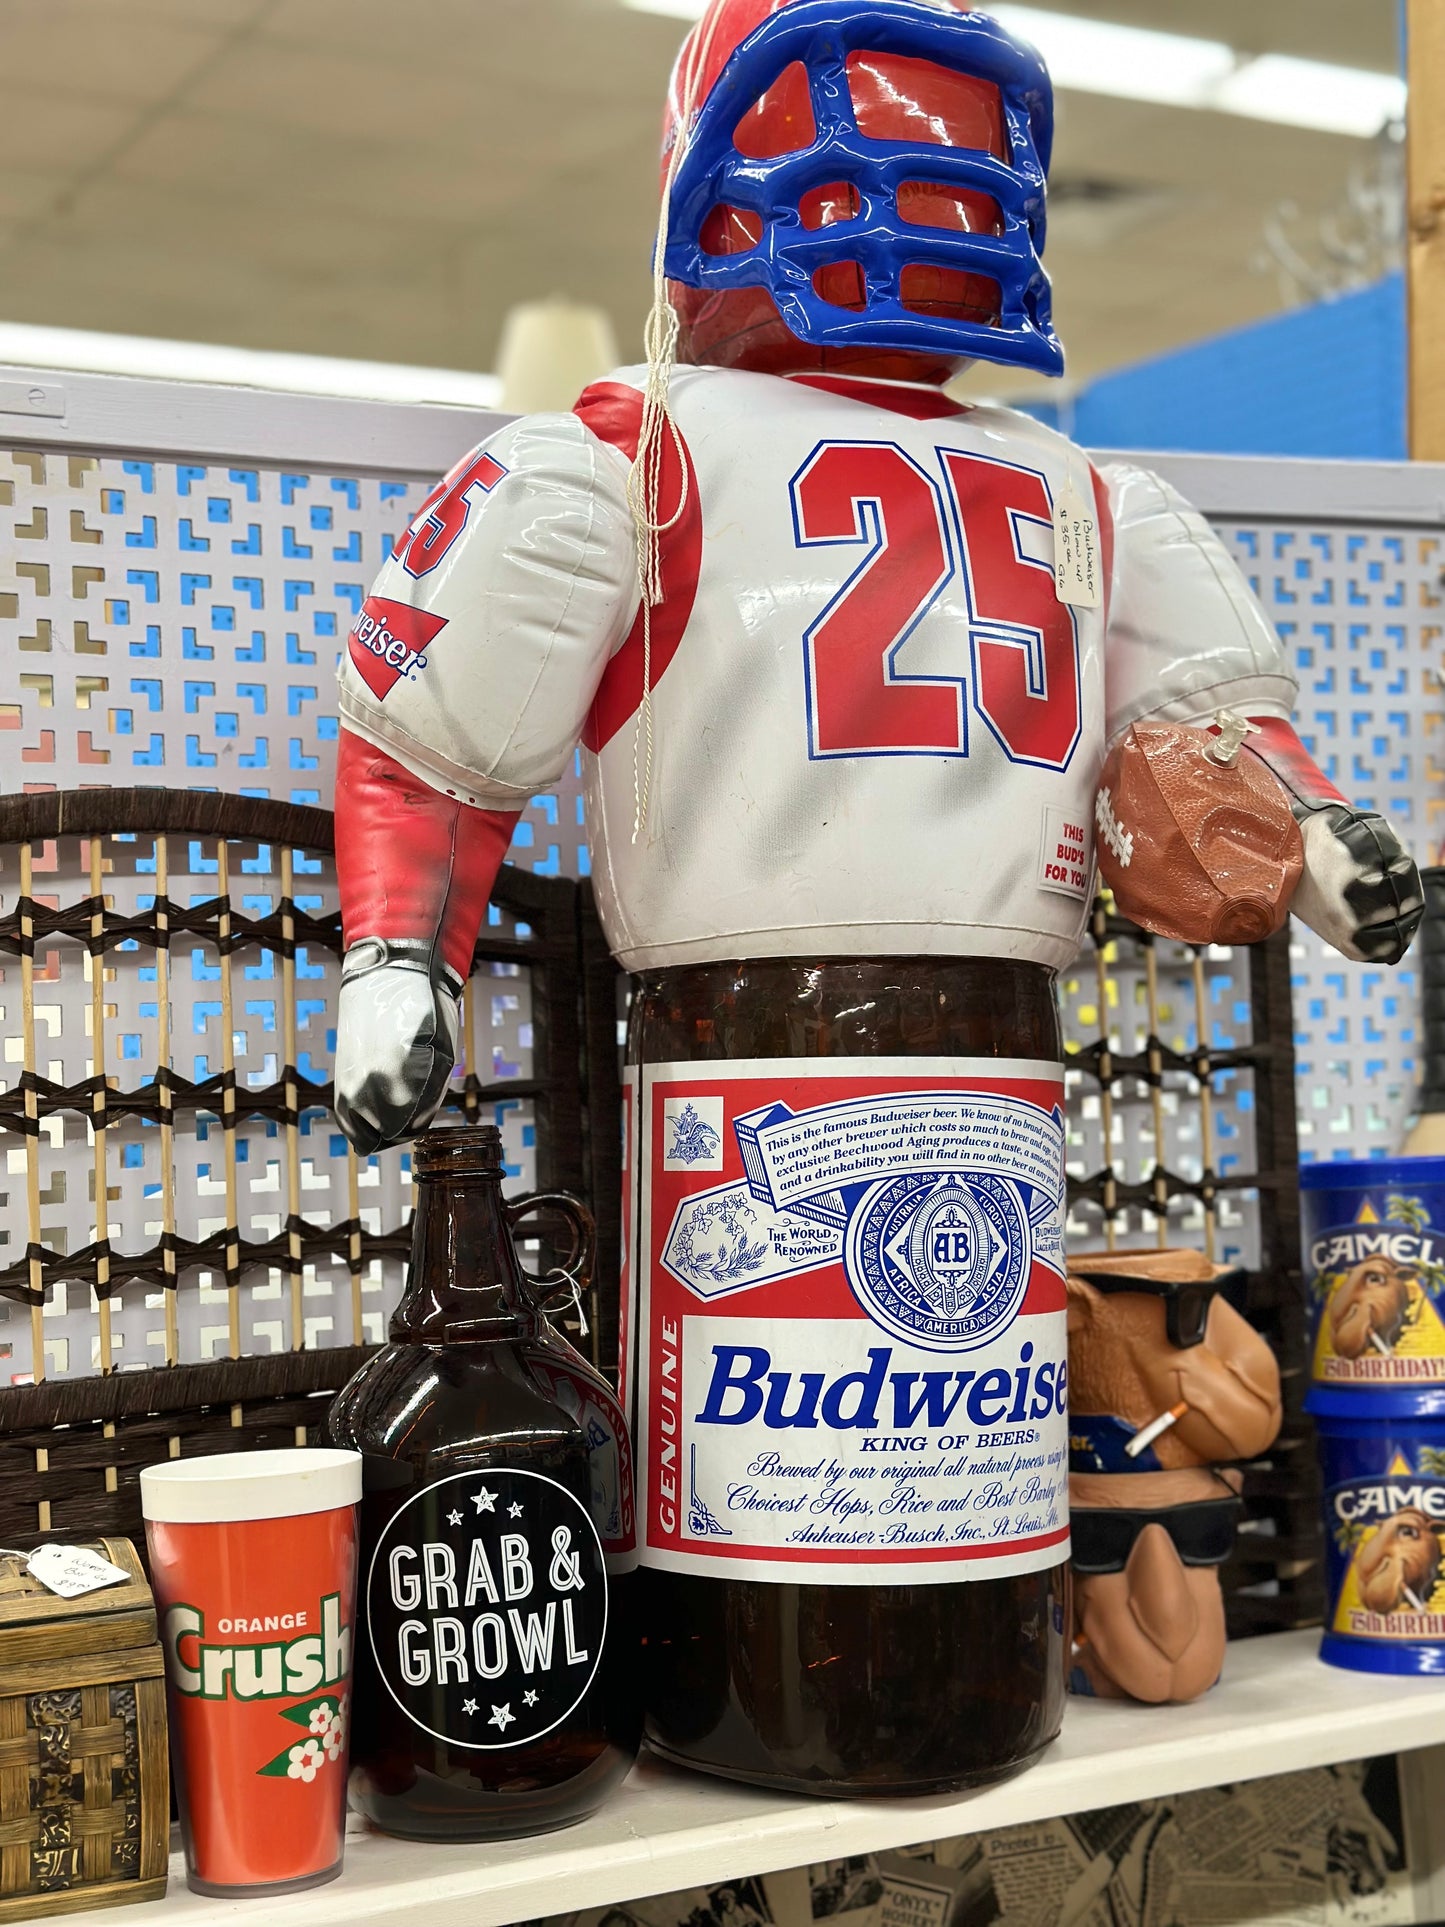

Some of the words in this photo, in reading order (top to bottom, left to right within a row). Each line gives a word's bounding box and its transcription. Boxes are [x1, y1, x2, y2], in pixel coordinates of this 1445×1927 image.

[788, 440, 1082, 773] 25
[1063, 822, 1084, 843] THIS
[1057, 843, 1085, 865] BUD'S
[1045, 863, 1067, 882] FOR
[1070, 869, 1087, 889] YOU
[766, 1138, 789, 1152] This
[792, 1133, 802, 1144] is
[803, 1128, 821, 1140] the
[823, 1117, 868, 1133] famous
[870, 1109, 931, 1124] Budweiser
[933, 1108, 957, 1119] beer.
[961, 1108, 975, 1119] We
[976, 1110, 1001, 1121] know
[1003, 1115, 1013, 1124] of
[1012, 1118, 1022, 1127] no
[1023, 1119, 1043, 1136] brand
[772, 1155, 785, 1165] by
[787, 1147, 809, 1158] any
[811, 1136, 843, 1151] other
[846, 1128, 889, 1143] brewer
[891, 1123, 926, 1135] which
[929, 1123, 957, 1132] costs
[972, 1125, 999, 1136] much
[1000, 1127, 1009, 1138] to
[1010, 1129, 1029, 1143] brew
[1029, 1138, 1043, 1150] and
[776, 1154, 831, 1178] exclusive
[833, 1137, 904, 1160] Beechwood
[906, 1136, 941, 1149] Aging
[942, 1136, 991, 1148] produces
[993, 1141, 999, 1149] a
[1001, 1141, 1022, 1156] taste,
[1024, 1149, 1030, 1157] a
[779, 1175, 802, 1191] and
[804, 1174, 812, 1183] a
[815, 1156, 885, 1179] drinkability
[886, 1153, 909, 1167] you
[912, 1150, 934, 1161] will
[936, 1149, 958, 1159] find
[960, 1149, 970, 1160] in
[972, 1152, 986, 1161] no
[987, 1153, 1011, 1166] other
[1011, 1157, 1028, 1170] beer
[1028, 1166, 1036, 1175] at
[1036, 1169, 1047, 1182] any
[888, 1194, 924, 1237] AUSTRALIA
[979, 1195, 1005, 1232] EUROPE
[774, 1243, 837, 1256] RENOWNED
[789, 1227, 835, 1242] WORLD
[934, 1232, 970, 1263] AB
[1311, 1233, 1444, 1269] CAMEL
[889, 1268, 922, 1307] AFRICA
[982, 1271, 1004, 1302] ASIA
[926, 1319, 976, 1334] AMERICA
[659, 1315, 677, 1534] GENUINE
[859, 1437, 928, 1452] KING
[937, 1435, 969, 1450] OF
[747, 1451, 826, 1479] Brewed
[824, 1459, 846, 1488] by
[849, 1466, 878, 1479] our
[881, 1457, 945, 1487] original
[943, 1456, 968, 1477] all
[967, 1452, 1016, 1476] natural
[1009, 1454, 1045, 1481] process
[727, 1483, 808, 1513] Choicest
[810, 1487, 874, 1524] Hops,
[879, 1486, 934, 1514] Rice
[936, 1489, 972, 1512] and
[973, 1481, 1018, 1511] Best
[988, 1515, 1010, 1537] St.
[388, 1533, 533, 1611] GRAB
[549, 1525, 586, 1591] &
[218, 1611, 307, 1633] ORANGE
[164, 1591, 351, 1702] Crush
[398, 1598, 589, 1687] GROWL
